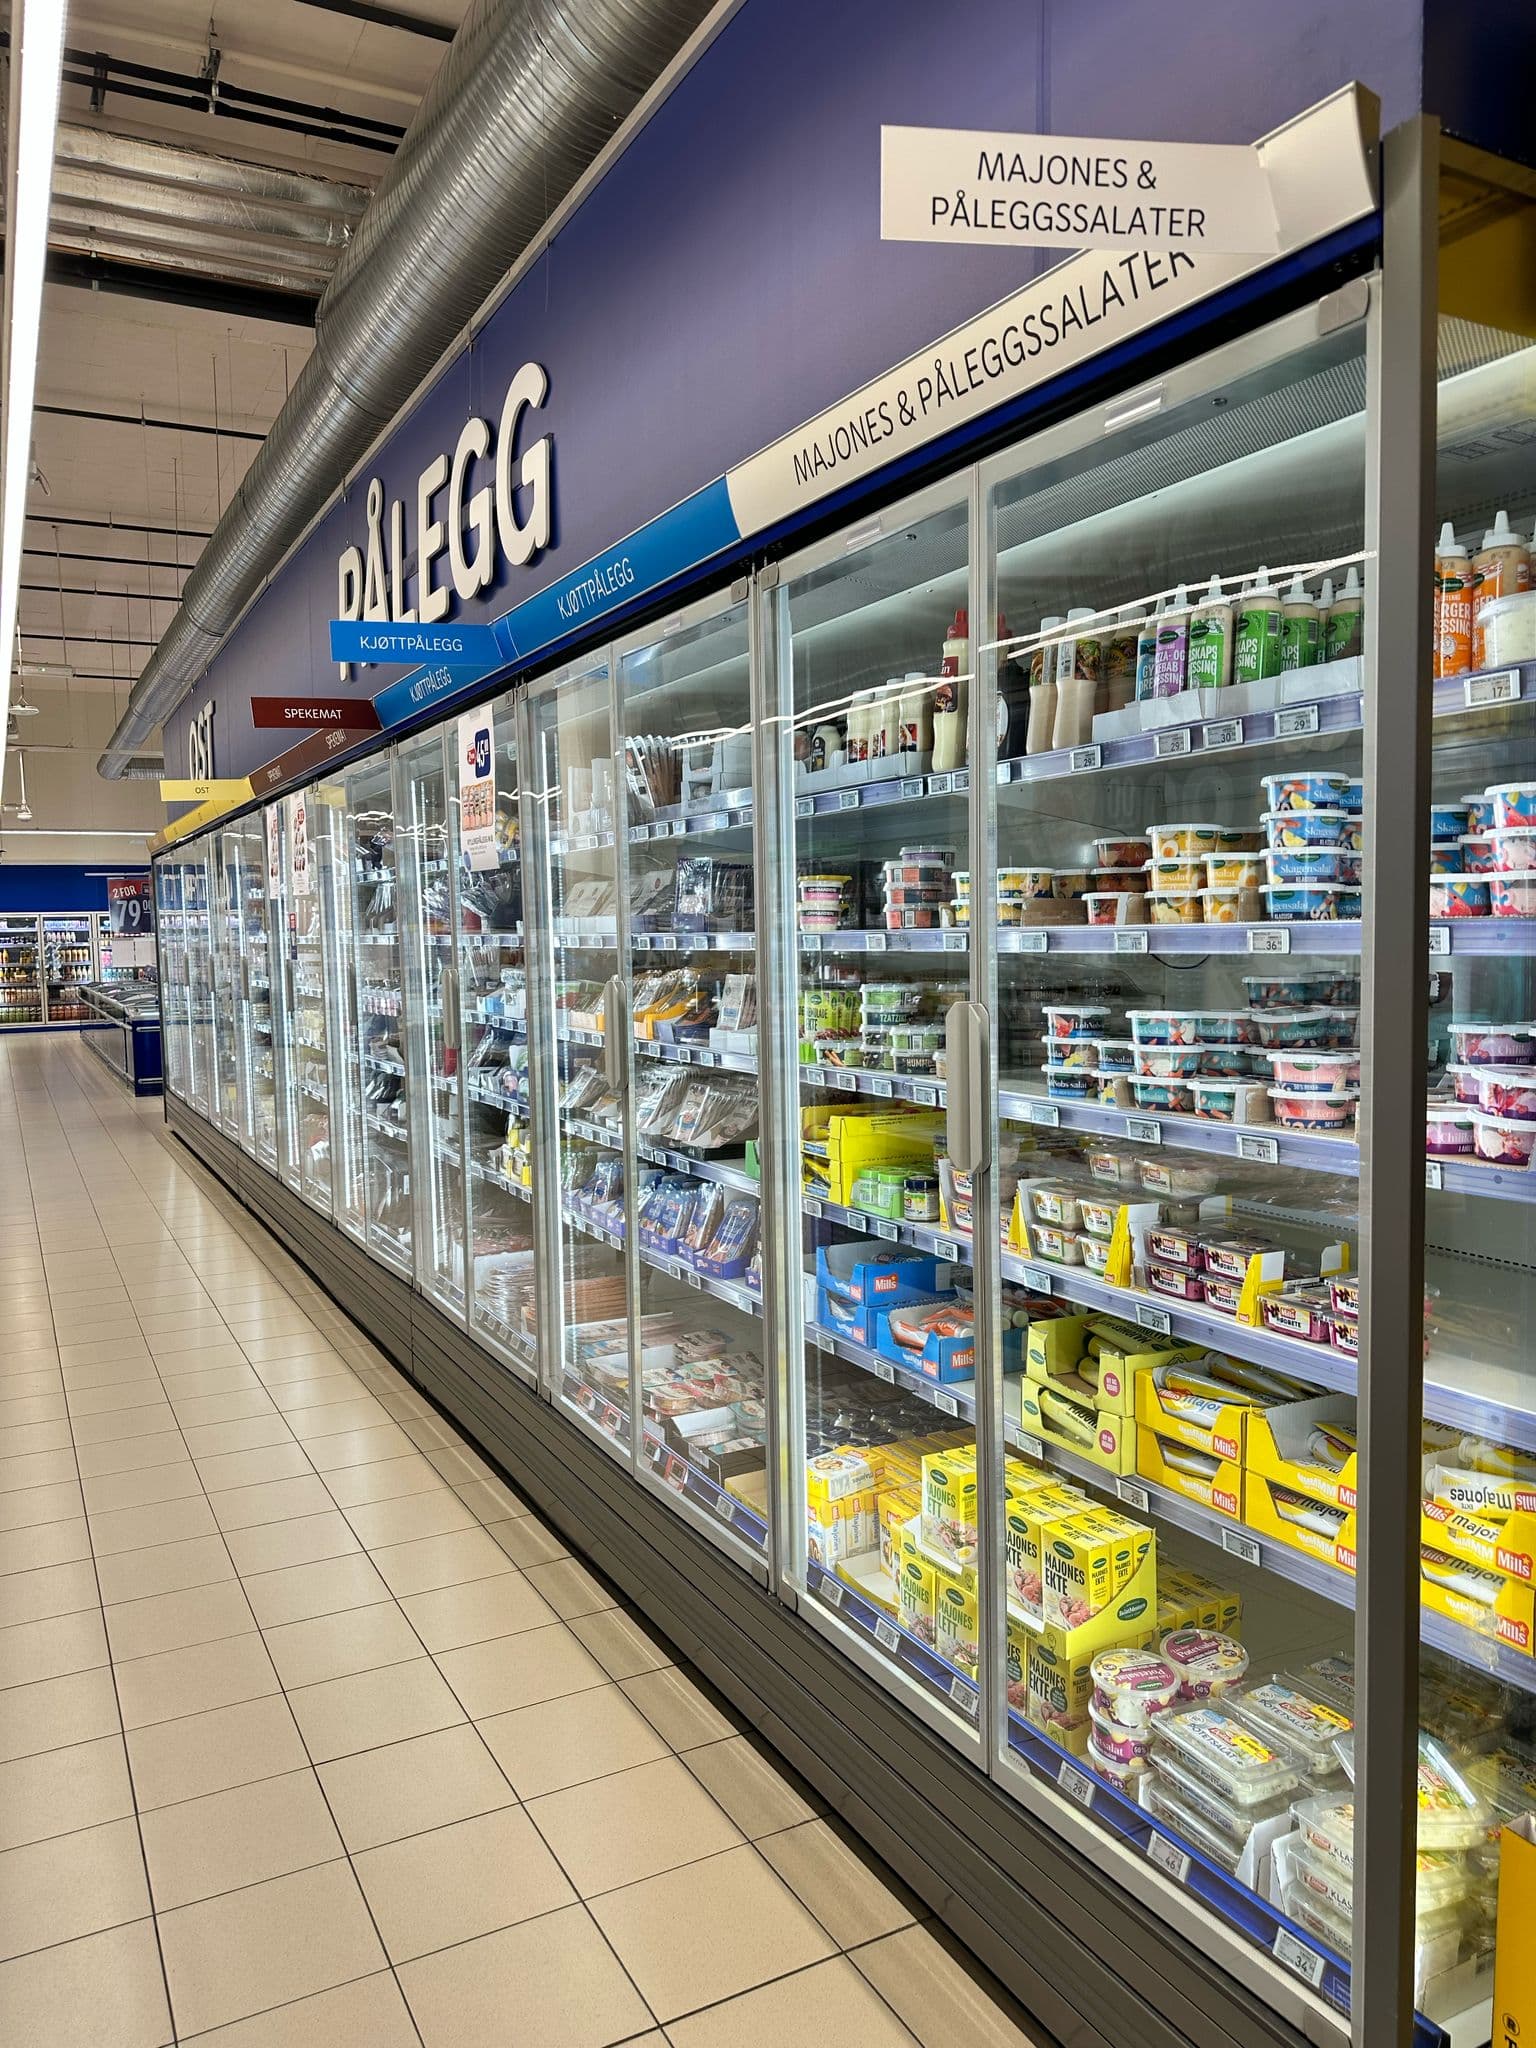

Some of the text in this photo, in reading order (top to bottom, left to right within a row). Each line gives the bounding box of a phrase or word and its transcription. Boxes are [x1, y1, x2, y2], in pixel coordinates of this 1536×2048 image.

[977, 150, 1158, 191] MAJONES &
[930, 188, 1207, 239] PÅLEGGSSALATER
[791, 400, 896, 486] MAJONES
[897, 389, 918, 427] &
[338, 361, 553, 682] PÅLEGG
[556, 557, 635, 621] KJØTTPÅLEGG
[359, 633, 463, 652] KJØTTPÅLEGG
[408, 665, 453, 704] KJØTTPÅLEGG
[284, 708, 343, 720] SPEKEMAT
[1294, 719, 1305, 731] 29
[189, 700, 216, 781] OST
[194, 786, 210, 794] OST
[1280, 863, 1332, 875] Skagensalat
[112, 885, 137, 898] 2 FOR
[117, 900, 142, 927] 79
[1266, 940, 1278, 951] 36
[875, 1278, 897, 1291] Mills
[952, 1353, 974, 1368] Mills
[1214, 1436, 1236, 1458] Mills
[1214, 1490, 1236, 1513] Mills
[1450, 1486, 1512, 1511] majones
[1044, 1551, 1086, 1586] MAJONES
[1118, 1568, 1129, 1578] EKTE
[1497, 1549, 1531, 1577] Mills
[901, 1573, 930, 1605] MAJONES
[1045, 1568, 1068, 1597] EKTE
[938, 1615, 958, 1640] LETT
[939, 1598, 973, 1631] MAJONES
[1496, 1615, 1526, 1645] Mills
[1029, 1653, 1067, 1693] MAJONES
[1029, 1673, 1050, 1702] EKTE
[1258, 1698, 1313, 1733] POTETSALAT
[1187, 1722, 1238, 1760] POTETSALAT
[1072, 1783, 1083, 1795] 29
[1165, 1856, 1176, 1870] 46
[1294, 1955, 1308, 1972] 34
